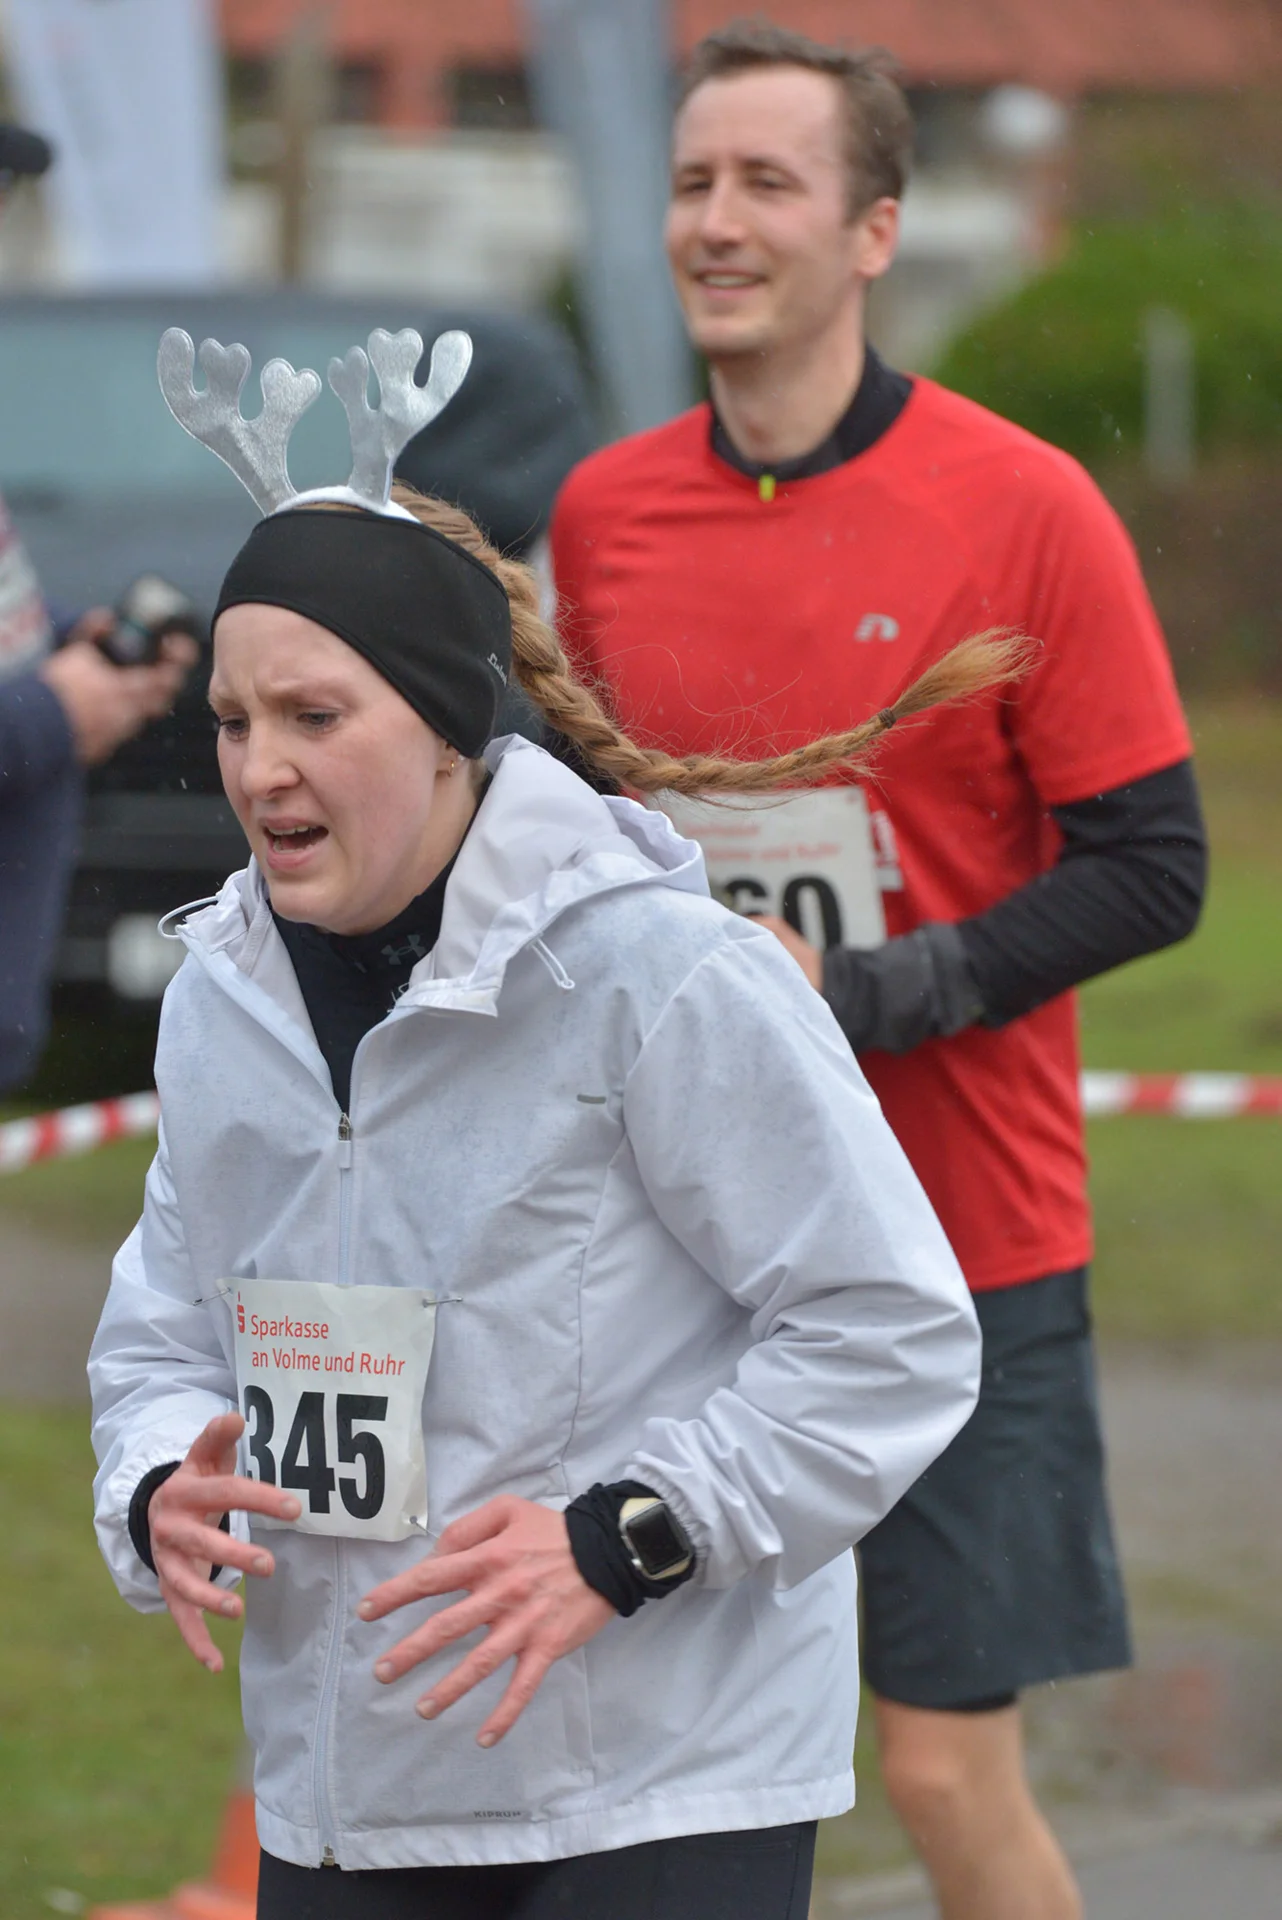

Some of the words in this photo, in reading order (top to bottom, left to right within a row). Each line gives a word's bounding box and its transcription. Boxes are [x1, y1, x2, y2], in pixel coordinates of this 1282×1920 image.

[250, 1314, 329, 1340] Sparkasse
[251, 1350, 269, 1367] an
[272, 1347, 321, 1371] Volme
[324, 1351, 355, 1373] und
[360, 1352, 406, 1376] Ruhr
[243, 1384, 389, 1520] 345
